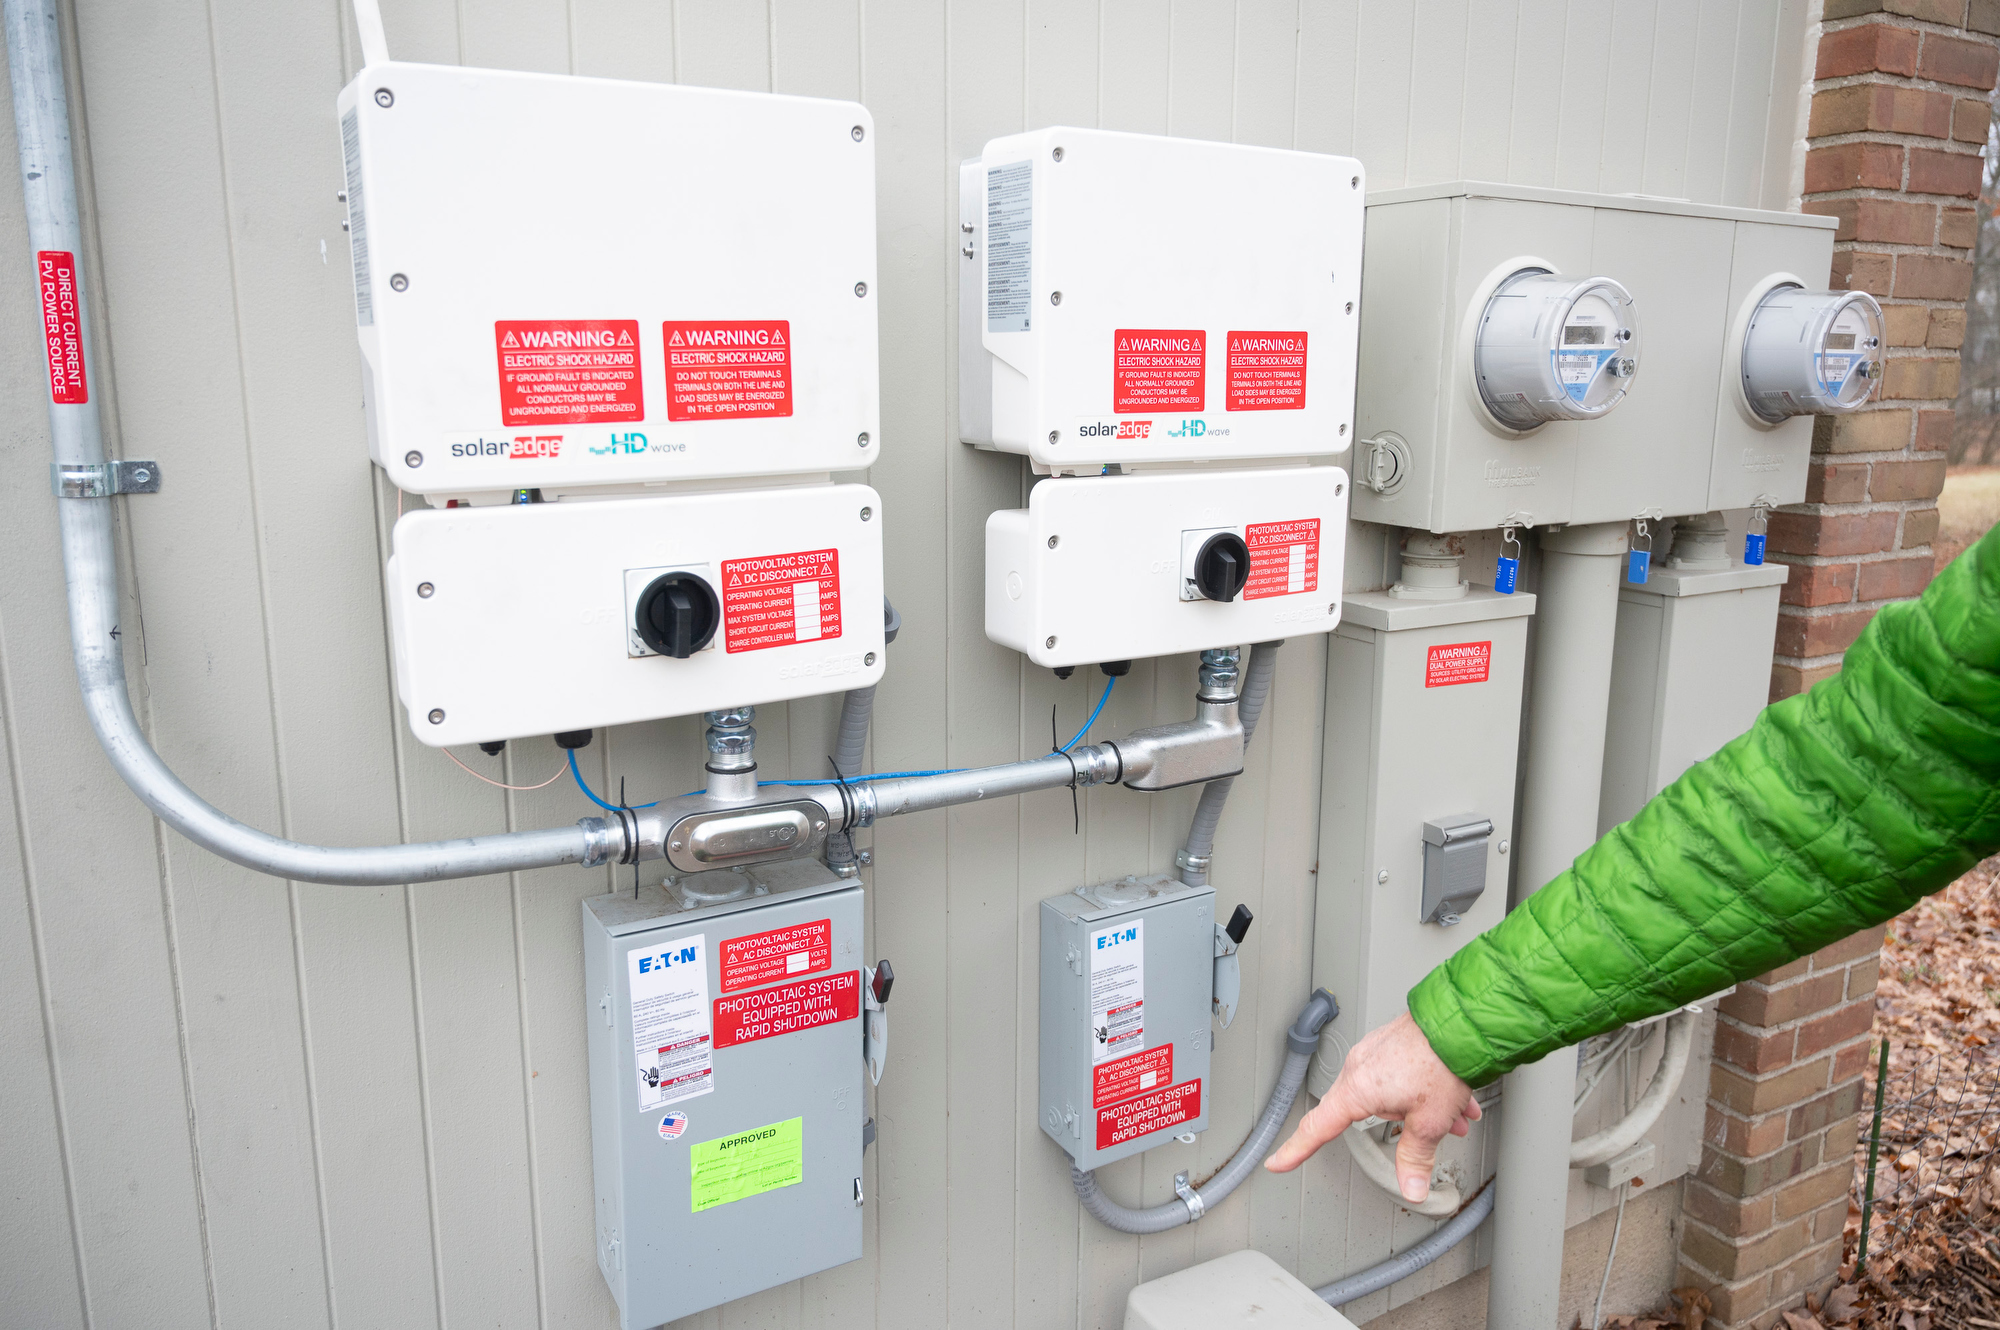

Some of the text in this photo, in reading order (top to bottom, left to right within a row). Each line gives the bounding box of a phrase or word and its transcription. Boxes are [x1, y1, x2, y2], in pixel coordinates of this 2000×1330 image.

[41, 260, 65, 394] PV POWER SOURCE
[58, 268, 81, 388] DIRECT CURRENT
[520, 330, 615, 348] WARNING
[685, 329, 768, 345] WARNING
[1130, 338, 1189, 350] WARNING
[1241, 338, 1293, 350] WARNING
[503, 353, 634, 367] ELECTRIC SHOCK HAZARD
[670, 351, 784, 364] ELECTRIC SHOCK HAZARD
[1118, 356, 1200, 365] ELECTRIC SHOCK HAZARD
[1231, 356, 1303, 365] ELECTRIC SHOCK HAZARD
[506, 371, 634, 382] IF GROUND FAULT IS INDICATED
[676, 369, 781, 380] DO NOT TOUCH TERMINALS
[516, 382, 626, 393] ALL NORMALLY GROUNDED
[674, 380, 785, 391] TERMINALS ON BOTH THE LINE AND
[525, 393, 616, 404] CONDUCTORS MAY BE
[675, 391, 784, 403] LOAD SIDES MAY BE ENERGIZED
[509, 403, 636, 416] UNGROUNDED AND ENERGIZED
[687, 402, 774, 413] IN THE OPEN POSITION
[1079, 421, 1151, 440] solaredge
[1183, 420, 1230, 437] HD wave
[451, 435, 562, 460] solaredge
[612, 433, 686, 454] HD wave
[1248, 521, 1317, 535] PHOTOVOLTAIC SYSTEM
[1259, 531, 1306, 544] DC DISCONNECT
[726, 551, 833, 573] PHOTOVOLTAIC SYSTEM
[744, 565, 818, 583] DC DISCONNECT
[726, 580, 832, 601] OPERATING VOLTAGE VDC
[727, 591, 837, 613] OPERATING CURRENT AMPS
[728, 603, 834, 624] MAX SYSTEM VOLTAGE VDC
[728, 614, 838, 636] SHORT CIRCUIT CURRENT AMPS
[729, 625, 839, 648] CHARGE CONTROLLER MAX AMPS
[1438, 646, 1480, 659] WARNING
[1429, 657, 1487, 669] DUAL POWER SUPPLY
[727, 924, 824, 952] PHOTOVOLTAIC SYSTEM
[742, 938, 810, 960] AC DISCONNECT
[726, 948, 826, 976] OPERATING VOLTAGE VOLTS
[725, 958, 825, 986] OPERATING CURRENT AMPS
[719, 984, 805, 1014] PHOTOVOLTAIC
[808, 975, 852, 996] SYSTEM
[742, 993, 831, 1024] EQUIPPED WITH
[736, 1006, 837, 1041] RAPID SHUTDOWN
[676, 1038, 700, 1048] DANGER
[1098, 1047, 1168, 1075] PHOTOVOLTAIC SYSTEM
[1109, 1059, 1157, 1081] AC DISCONNECT
[679, 1071, 704, 1082] PELIGRO
[1097, 1067, 1169, 1095] OPERATING VOLTAGE VOLTS
[1096, 1090, 1119, 1102] OPERATING
[1120, 1084, 1138, 1095] CURRENT
[1101, 1082, 1196, 1122] PHOTOVOLTAIC SYSTEM
[1117, 1099, 1180, 1129] EQUIPPED WITH
[1112, 1108, 1185, 1143] RAPID SHUTDOWN
[720, 1129, 776, 1150] APPROVED
